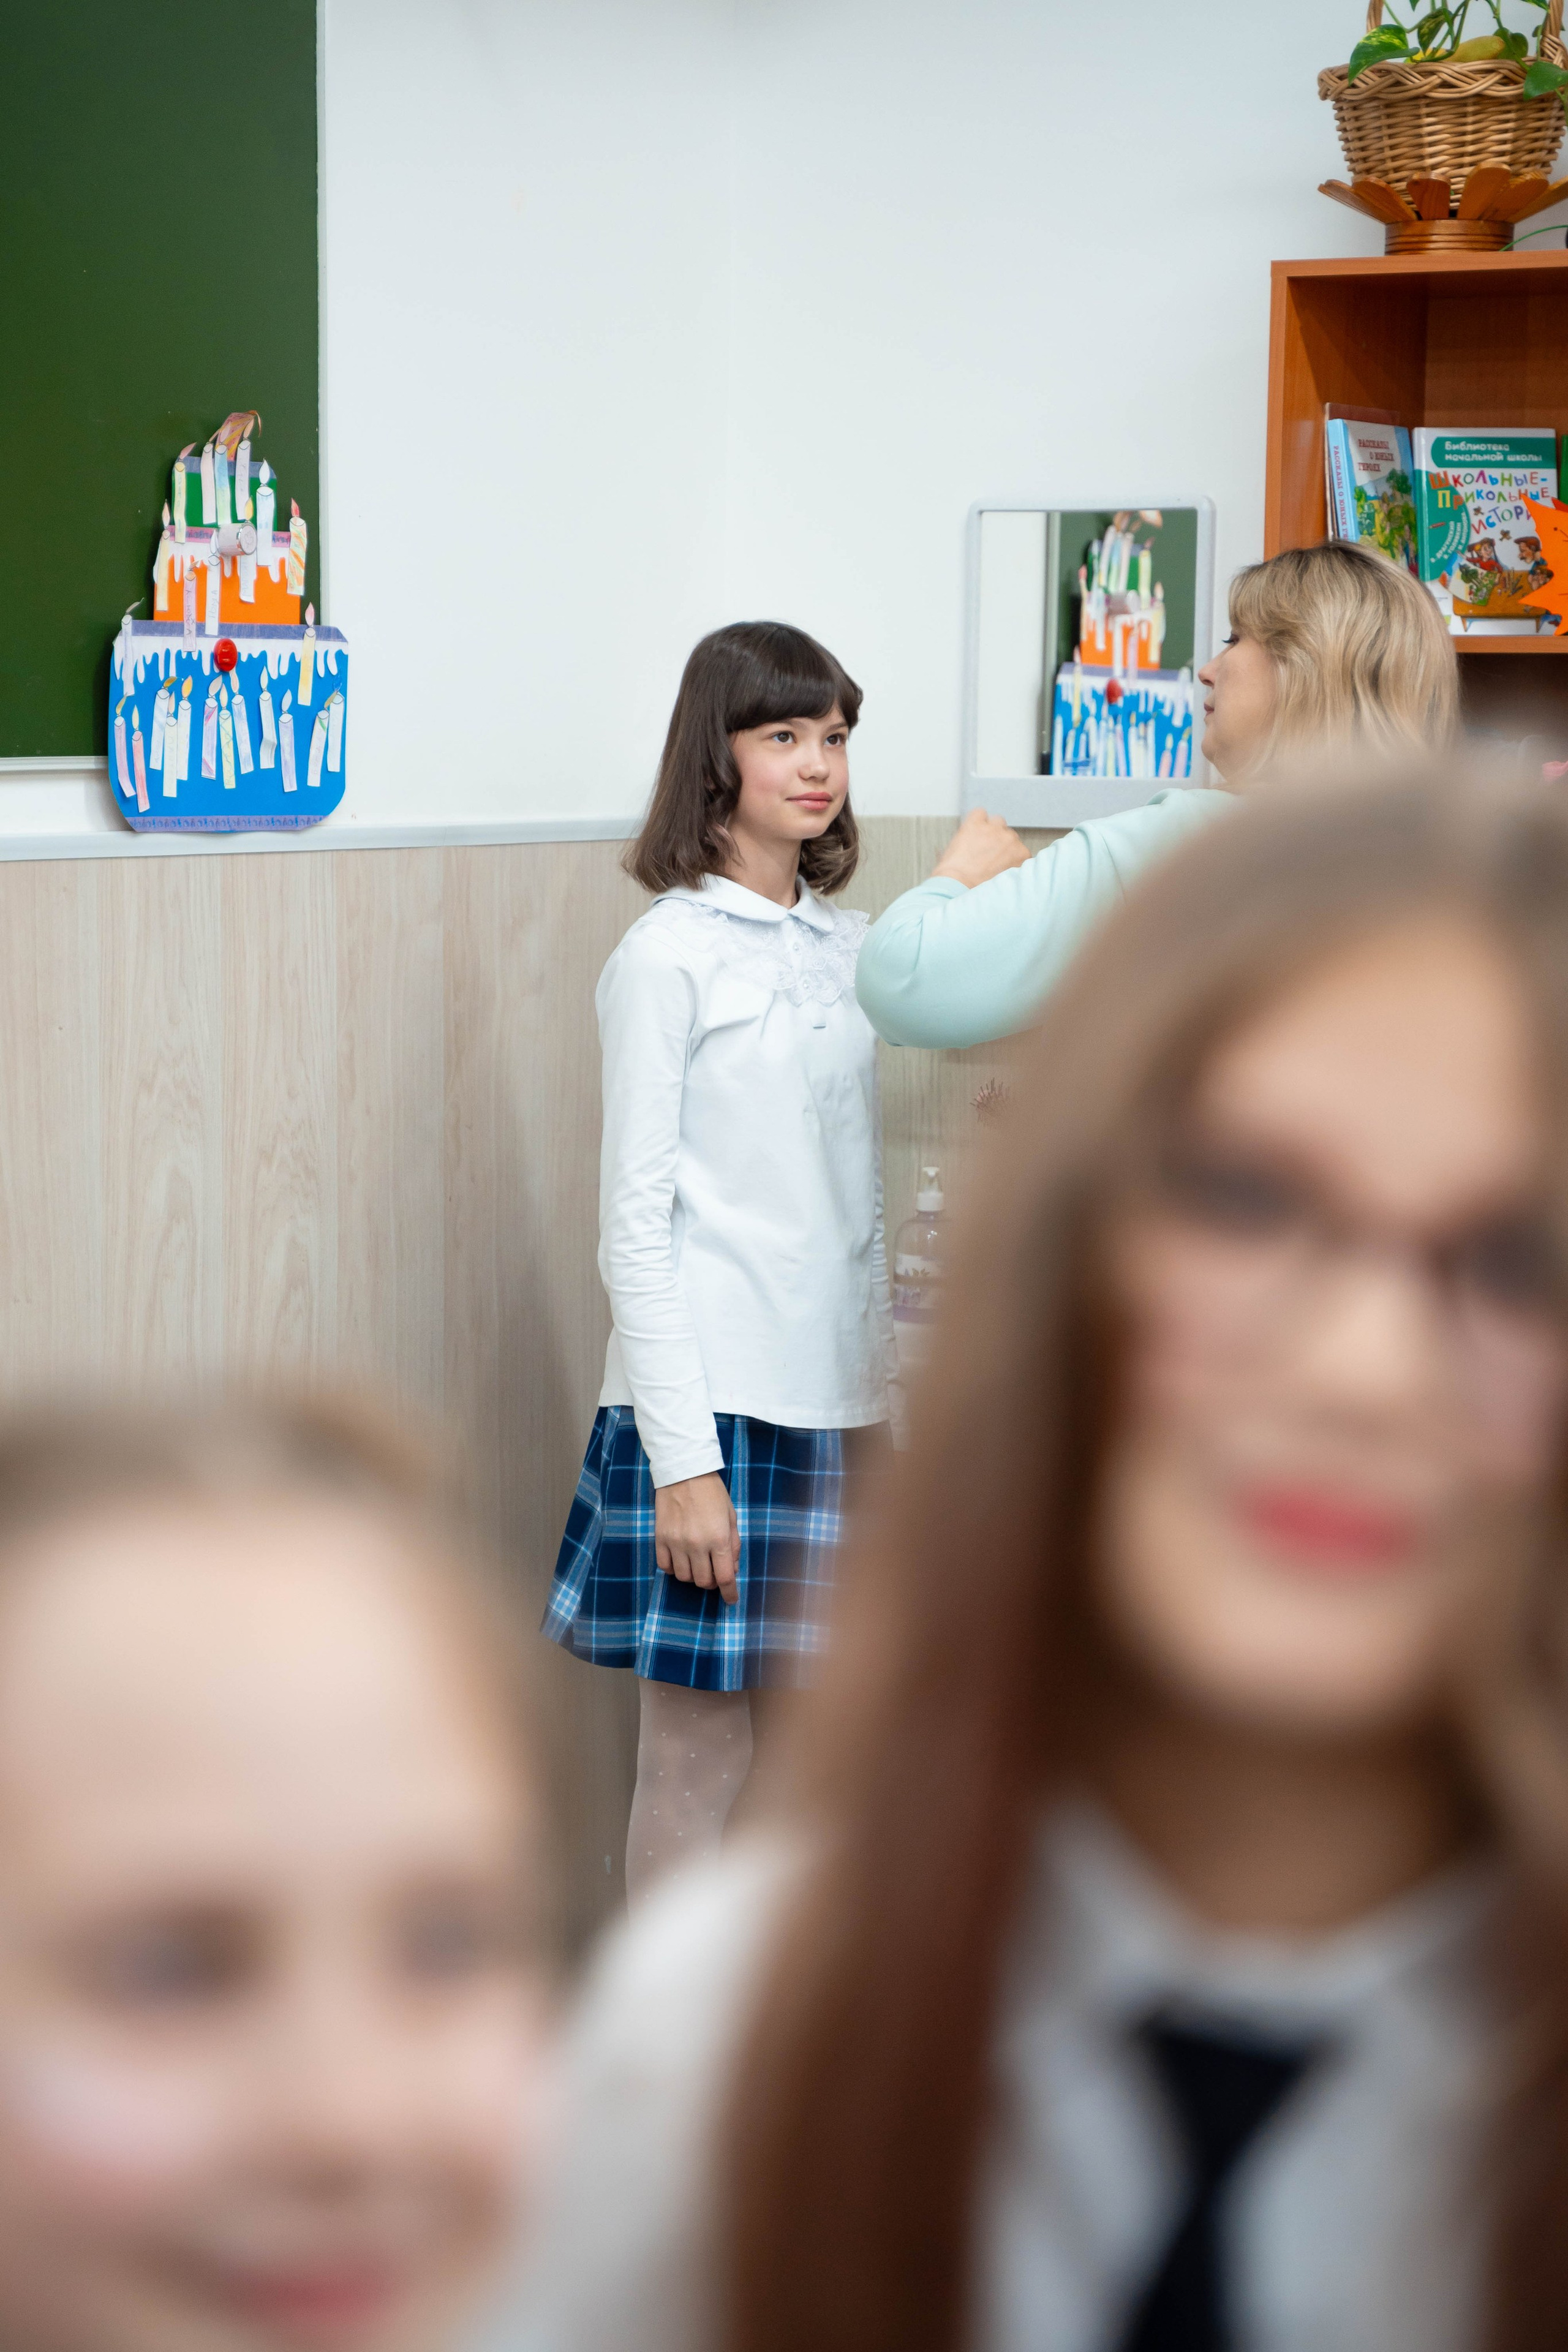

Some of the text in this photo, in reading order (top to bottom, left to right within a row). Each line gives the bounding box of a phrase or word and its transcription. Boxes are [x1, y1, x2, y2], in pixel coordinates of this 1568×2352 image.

[1444, 440, 1510, 451] Библиотека
[1444, 451, 1504, 461] начальной
[1333, 445, 1343, 489] РАССКАЗЫ
[1339, 499, 1348, 527] ЮНЫХ
[1428, 470, 1548, 489] ШКОЛЬНЫЕ-
[1437, 487, 1550, 510] ПРИКОЛЬНЫЕ
